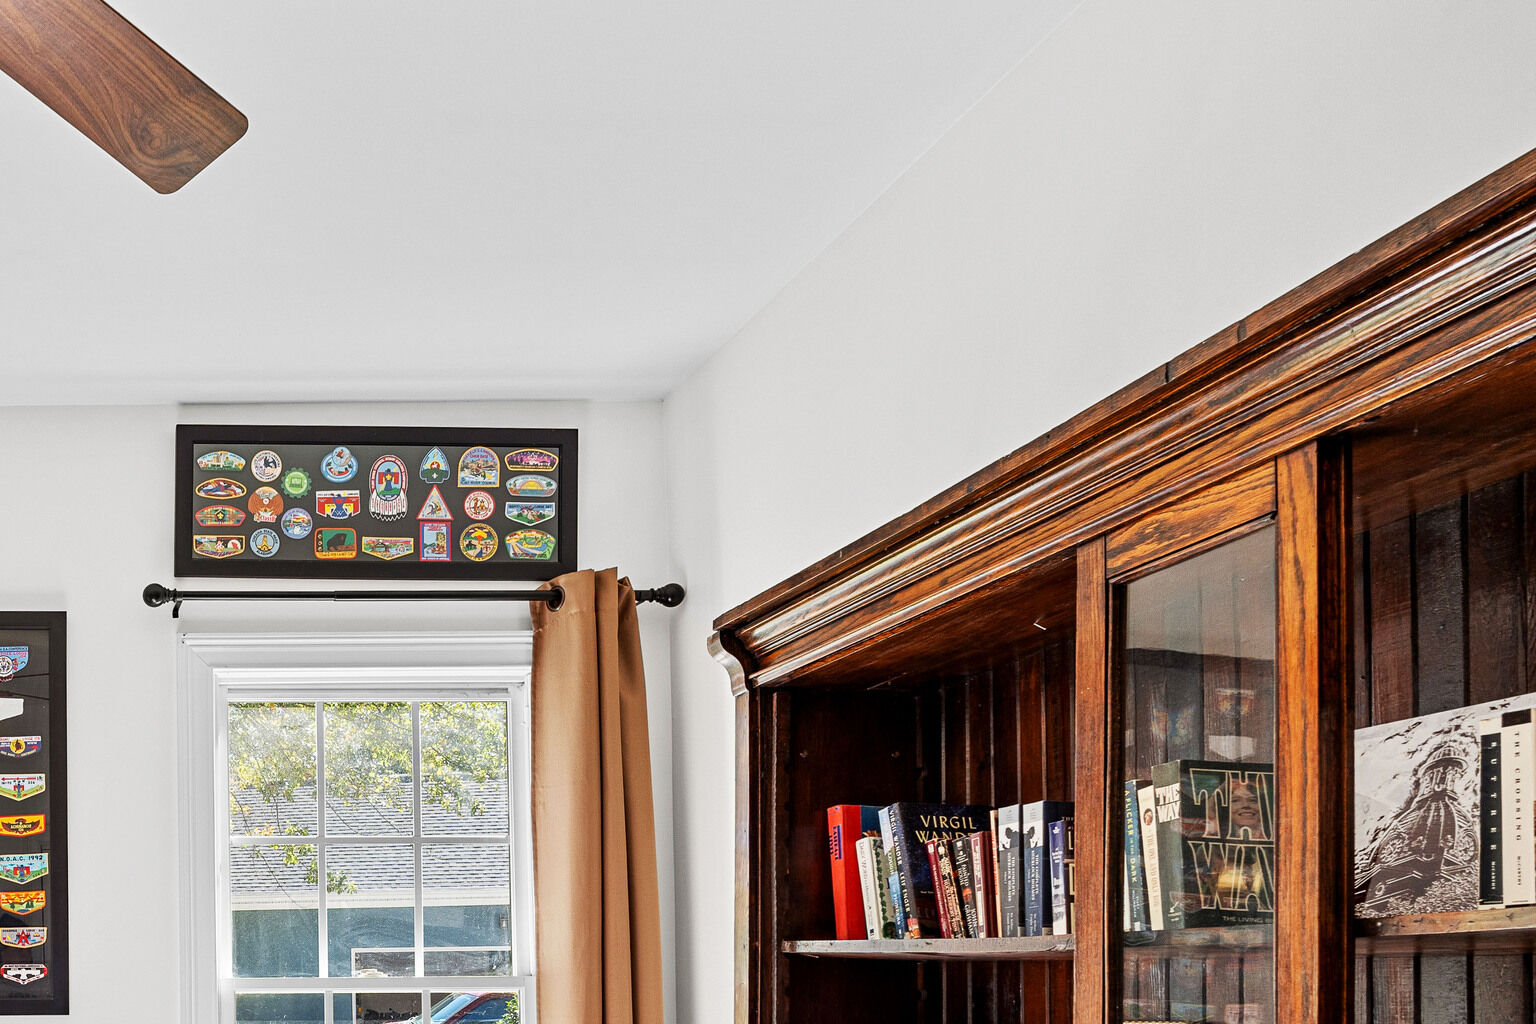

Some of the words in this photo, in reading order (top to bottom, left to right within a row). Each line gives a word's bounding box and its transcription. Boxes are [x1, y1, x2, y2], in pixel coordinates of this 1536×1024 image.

[1156, 783, 1181, 805] THE
[1189, 768, 1274, 841] TH
[920, 814, 977, 830] VIRGIL
[1156, 802, 1181, 823] WAY
[915, 830, 973, 843] WAND
[894, 836, 902, 865] WANDER
[1187, 840, 1274, 912] WA
